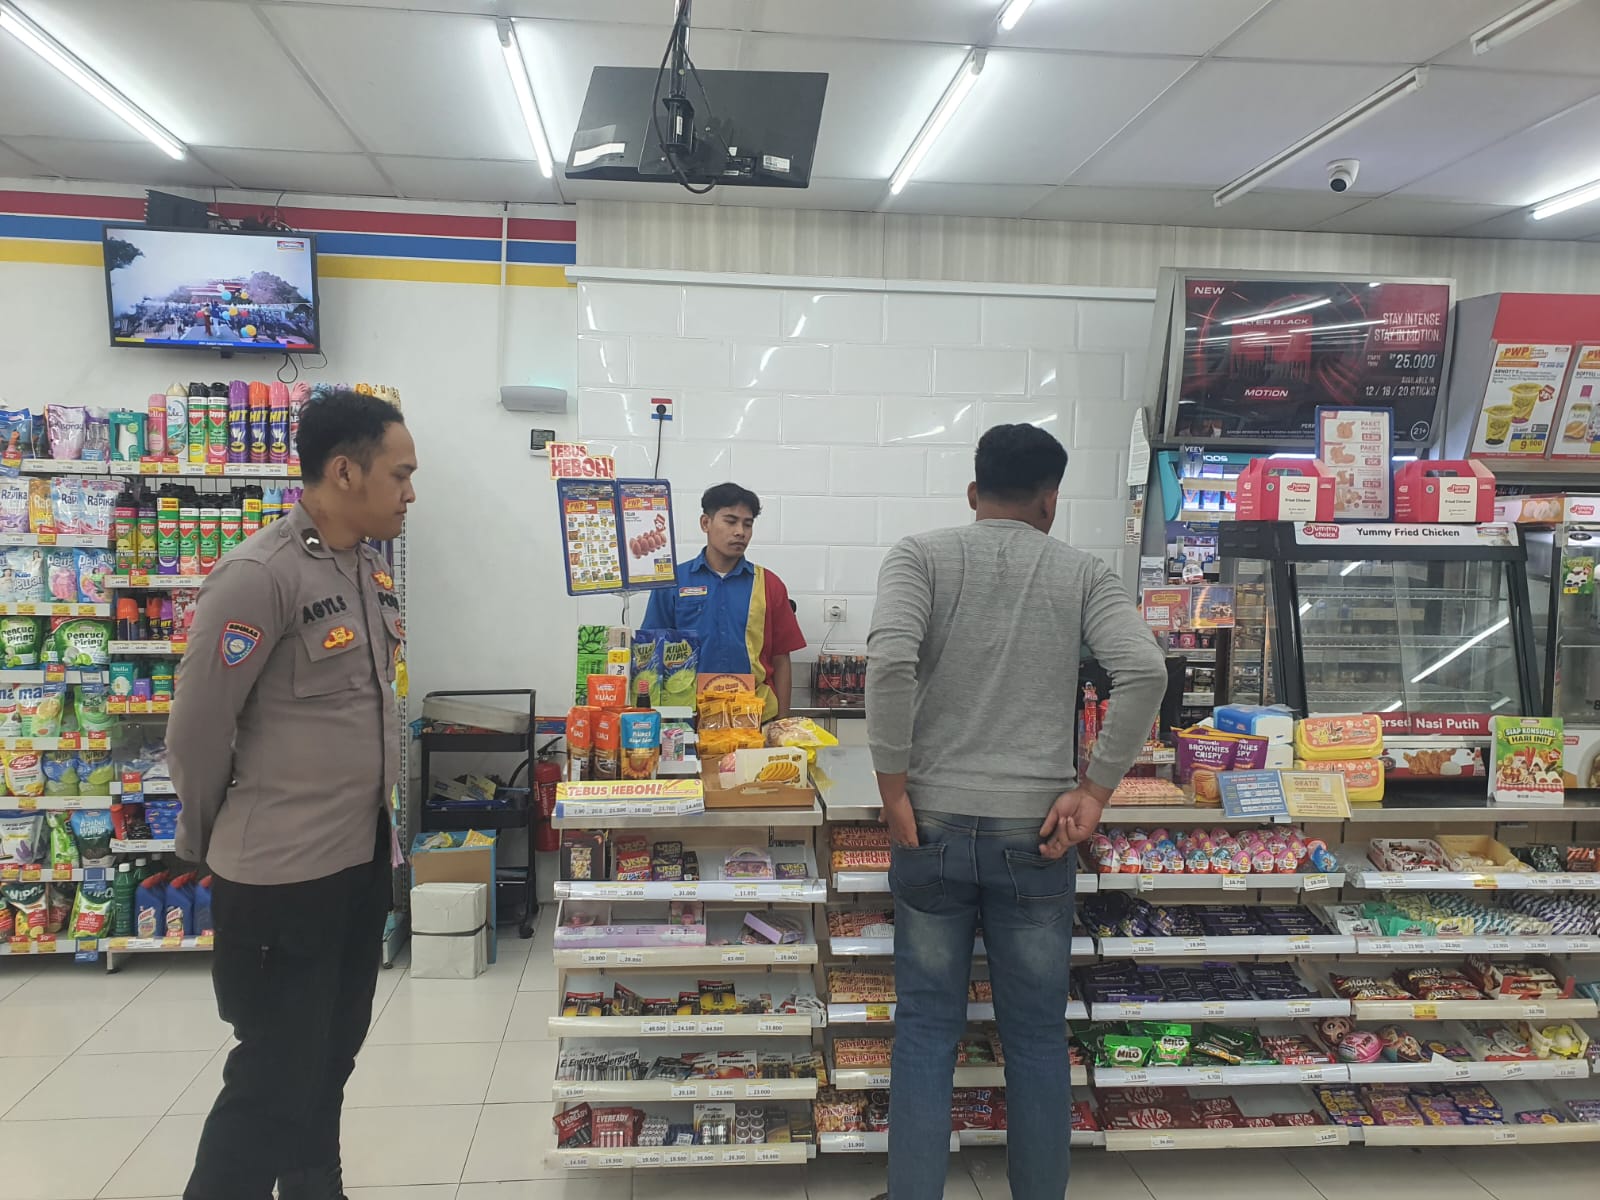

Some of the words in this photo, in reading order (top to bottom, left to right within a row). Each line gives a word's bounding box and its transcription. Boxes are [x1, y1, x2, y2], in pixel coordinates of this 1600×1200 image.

[1194, 286, 1225, 295] NEW
[1383, 312, 1402, 325] STAY
[1375, 329, 1396, 341] STAY
[1504, 347, 1530, 356] PWP
[1244, 389, 1288, 398] MOTION
[1365, 386, 1375, 396] 12
[1399, 386, 1409, 396] 20
[1410, 386, 1436, 396] STICKS
[229, 410, 248, 423] HIT
[250, 410, 268, 422] HIT
[270, 410, 289, 423] HIT
[1413, 427, 1427, 435] 21+
[551, 445, 587, 458] TEBUS
[552, 457, 614, 478] HEBOH!
[87, 495, 115, 507] Rapika
[1356, 528, 1392, 539] Yummy
[1395, 527, 1420, 537] Fried
[1422, 528, 1460, 537] Chicken
[7, 634, 35, 643] Piring
[67, 632, 104, 640] Pencuci
[74, 638, 103, 647] Piring
[1416, 718, 1443, 730] Nasi
[1446, 718, 1480, 730] Putih
[1522, 728, 1556, 737] KONSUMSI
[1189, 744, 1230, 754] BROWNIES
[1195, 751, 1222, 760] CRISPY
[568, 787, 608, 797] TEBUS
[611, 784, 663, 796] HEBOH!
[622, 856, 650, 867] UNO
[656, 864, 682, 872] UNO
[1164, 1038, 1185, 1047] MILO
[569, 1053, 608, 1065] Energizer
[1116, 1050, 1139, 1059] MILO
[596, 1113, 629, 1123] EVEREADY
[1136, 1109, 1170, 1128] KitKat
